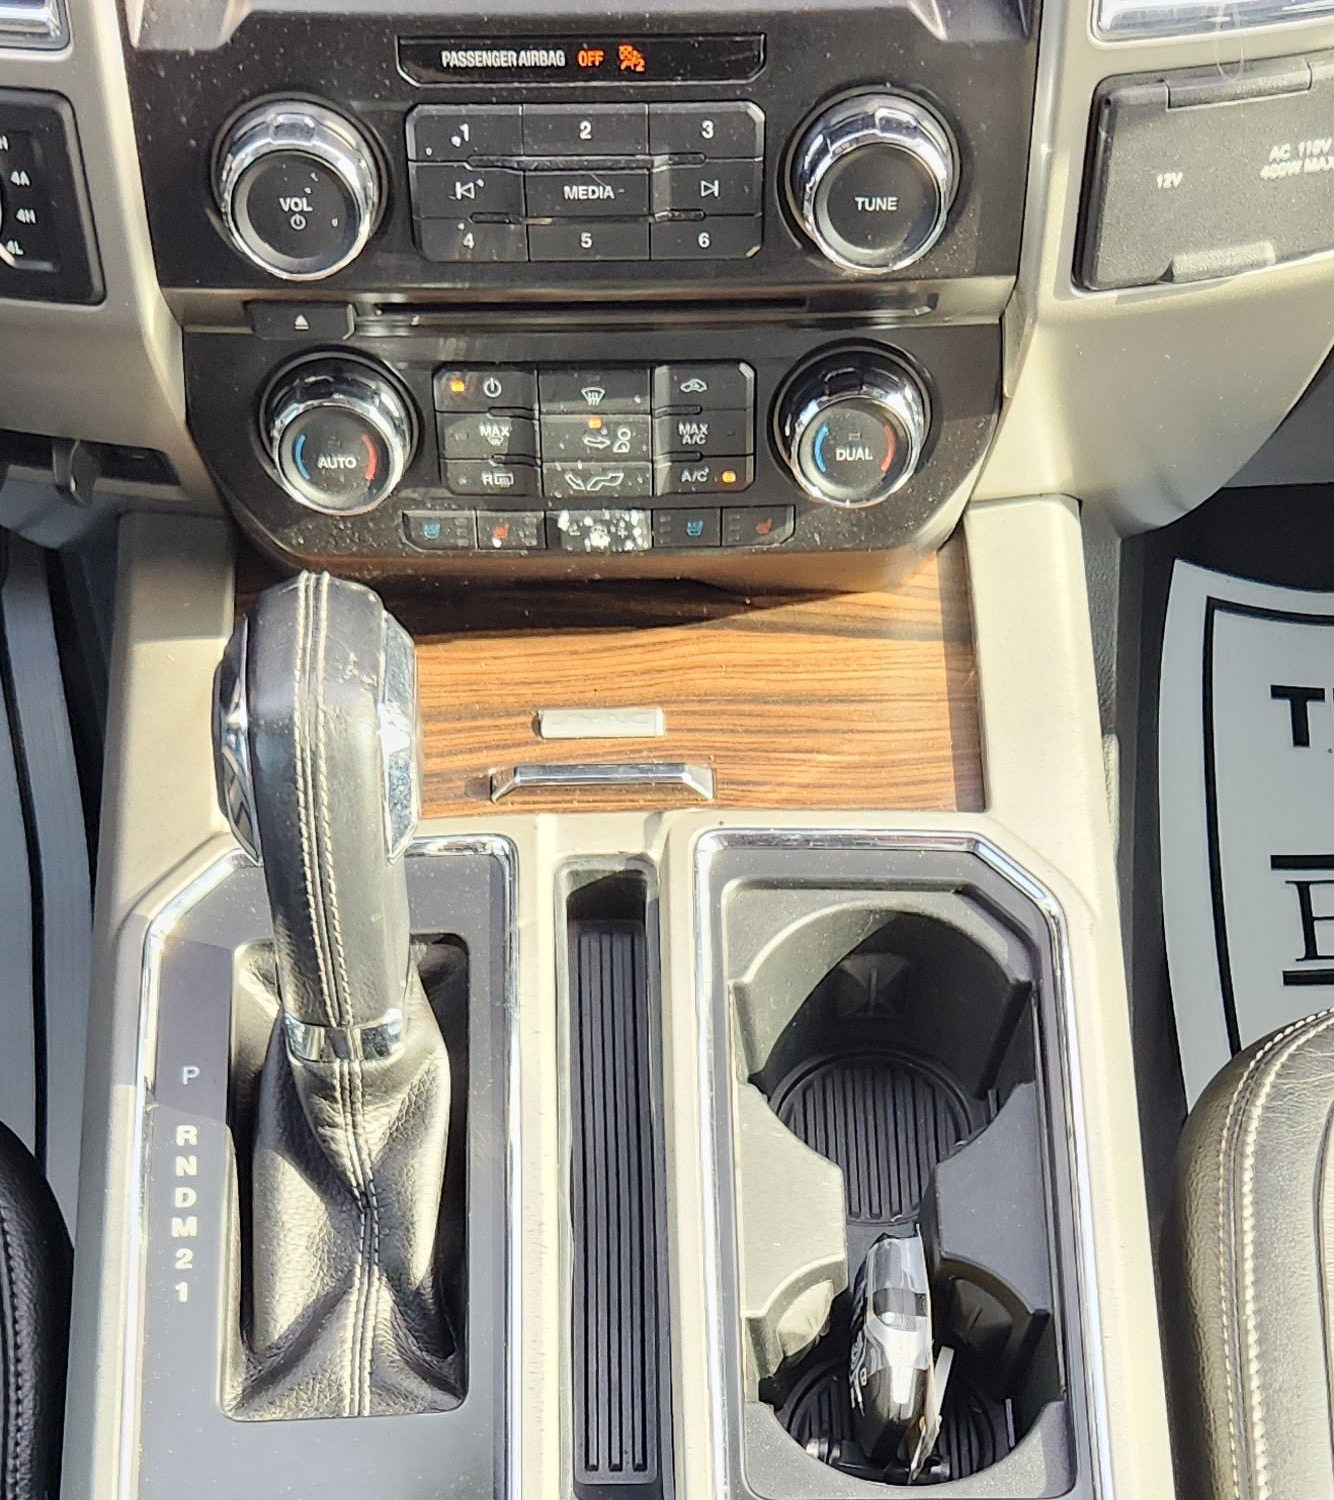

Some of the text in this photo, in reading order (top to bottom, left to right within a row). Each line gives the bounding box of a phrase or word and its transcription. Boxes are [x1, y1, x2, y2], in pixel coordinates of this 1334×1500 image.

[442, 50, 604, 67] PASSENGER AIRBAG OFF
[459, 123, 470, 142] 1
[579, 120, 592, 139] 2
[701, 120, 714, 139] 3
[1269, 143, 1291, 162] AC
[11, 170, 30, 186] 4A
[1156, 172, 1183, 189] 12V
[564, 185, 614, 200] MEDIA
[279, 197, 313, 212] VOL
[854, 196, 898, 212] TUNE
[16, 208, 36, 224] 4H
[6, 240, 24, 255] 4L
[462, 232, 474, 249] 4
[581, 232, 593, 249] 5
[698, 232, 710, 249] 6
[479, 425, 510, 437] MAX
[678, 424, 708, 436] MAX
[681, 434, 706, 446] A/C
[317, 456, 357, 469] AUTO
[835, 447, 873, 461] DUAL
[681, 470, 708, 483] A/C
[182, 1065, 200, 1085] P
[175, 1125, 198, 1147] R
[175, 1155, 197, 1177] N
[174, 1187, 197, 1208] D
[171, 1216, 197, 1238] M
[175, 1247, 193, 1269] 2
[175, 1281, 188, 1303] 1
